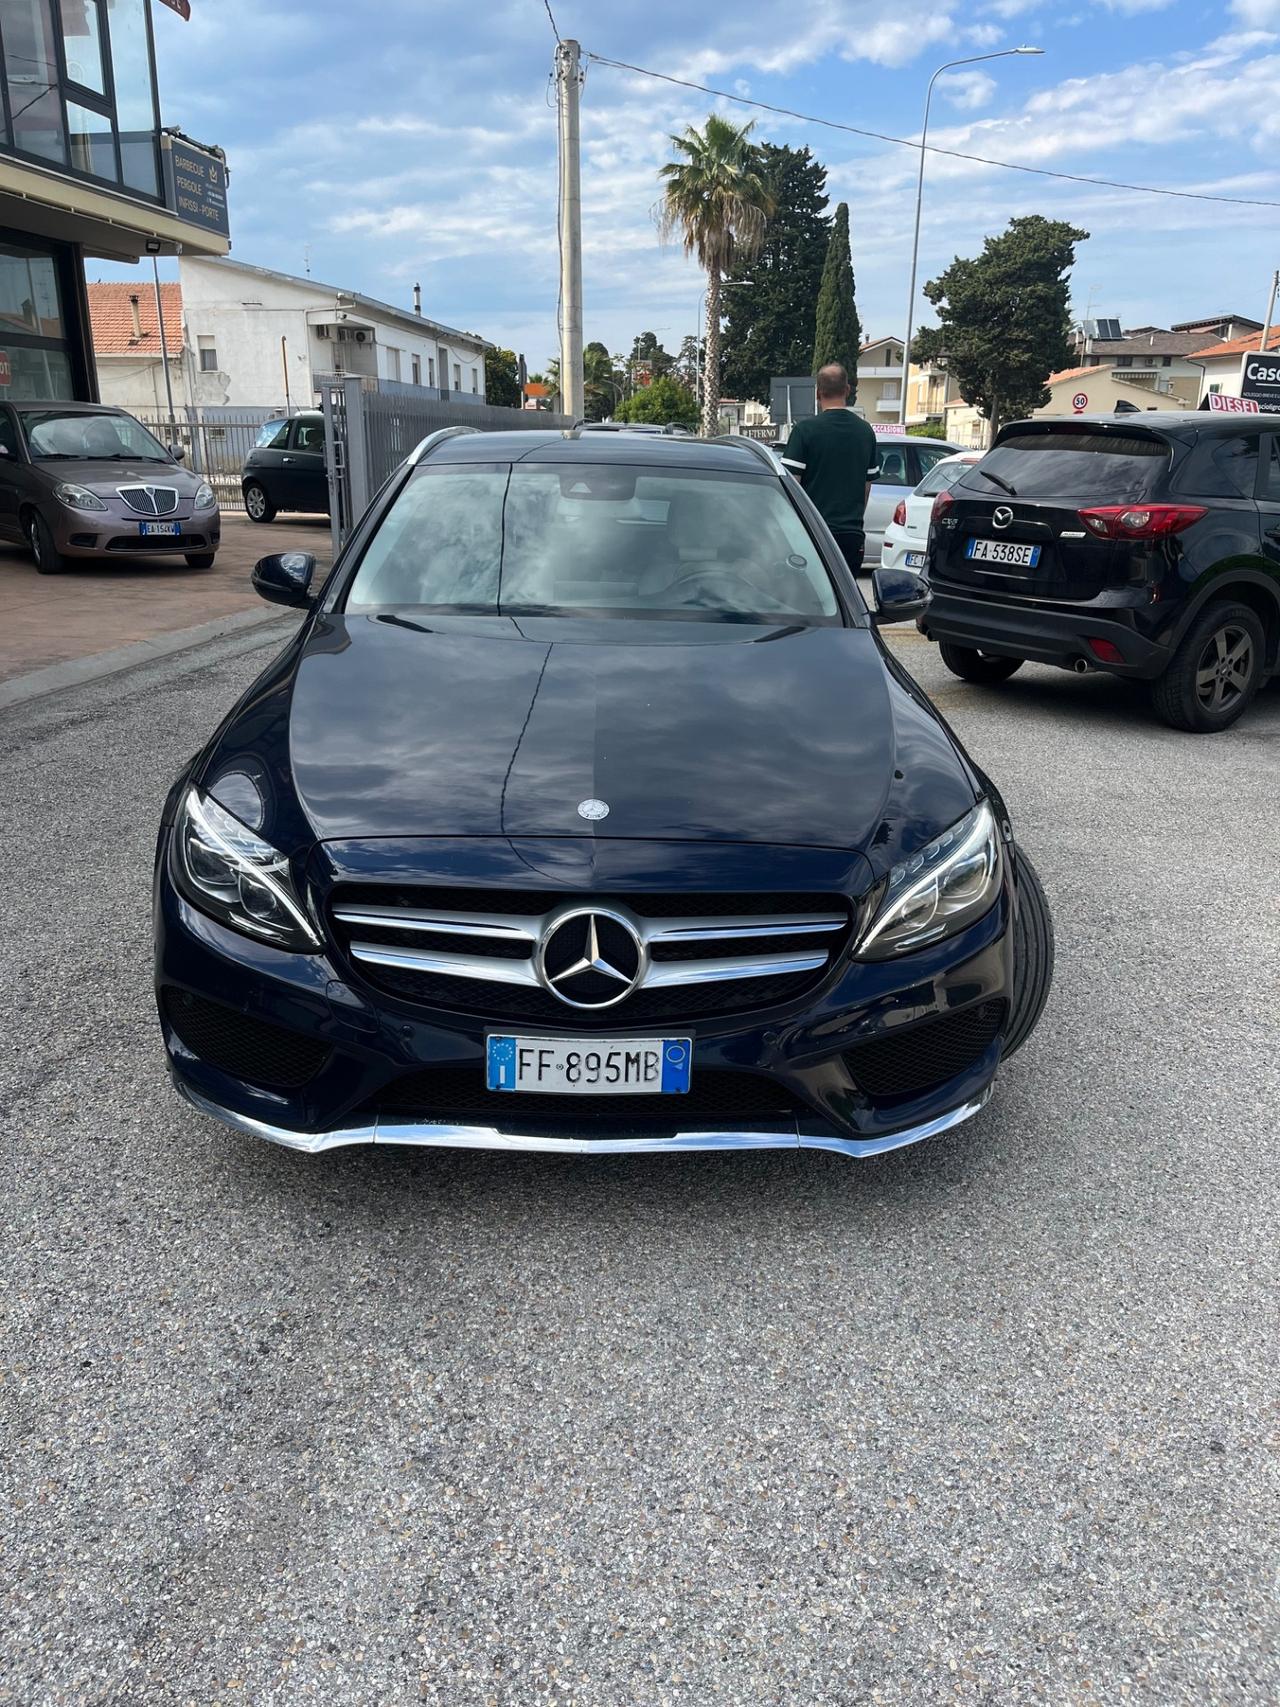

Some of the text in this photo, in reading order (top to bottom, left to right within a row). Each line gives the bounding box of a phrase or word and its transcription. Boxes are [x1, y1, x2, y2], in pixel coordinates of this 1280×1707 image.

[175, 155, 205, 178] BARBECUE
[177, 175, 202, 196] PERGOLE
[201, 204, 219, 221] PORTE
[1076, 397, 1085, 405] 50
[748, 429, 776, 438] ETERNO
[974, 541, 988, 559] FA
[993, 545, 1031, 564] 538SE
[519, 1048, 555, 1081] FF
[565, 1051, 659, 1083] 895MB
